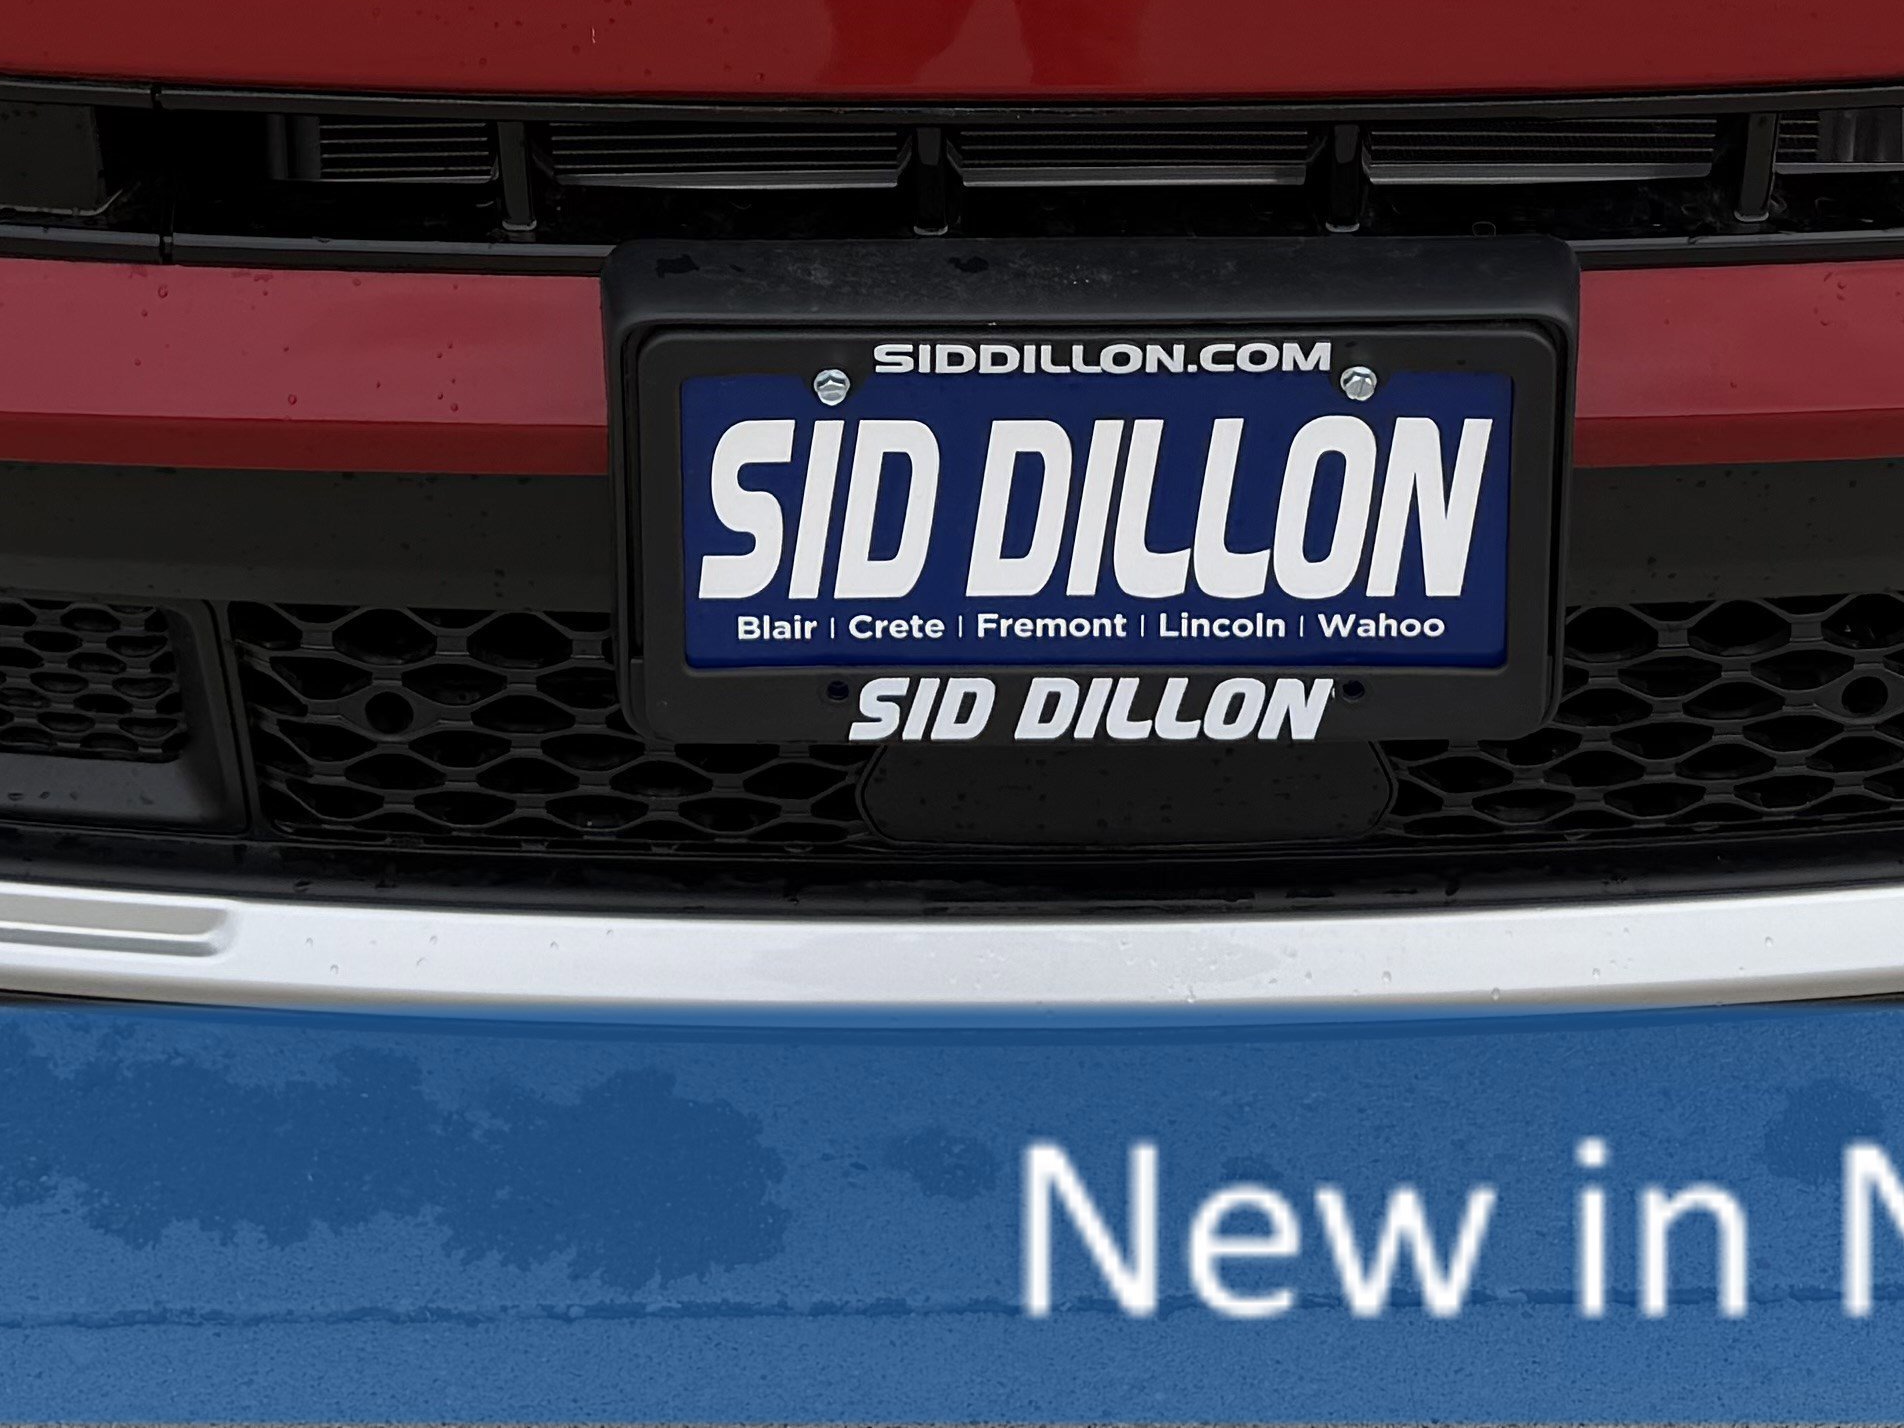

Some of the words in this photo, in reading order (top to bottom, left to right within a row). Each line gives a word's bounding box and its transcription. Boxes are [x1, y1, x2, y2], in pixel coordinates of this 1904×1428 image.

[874, 342, 1332, 374] SIDDILLON.COM
[698, 418, 940, 600] SID
[965, 415, 1493, 600] DILLON
[737, 614, 818, 640] Blair
[848, 614, 945, 639] Crete
[977, 613, 1127, 638] Fremont
[1159, 612, 1286, 638] Lincoln
[1317, 612, 1445, 638] Wahoo
[848, 677, 996, 741] SID
[1014, 677, 1334, 740] DILLON
